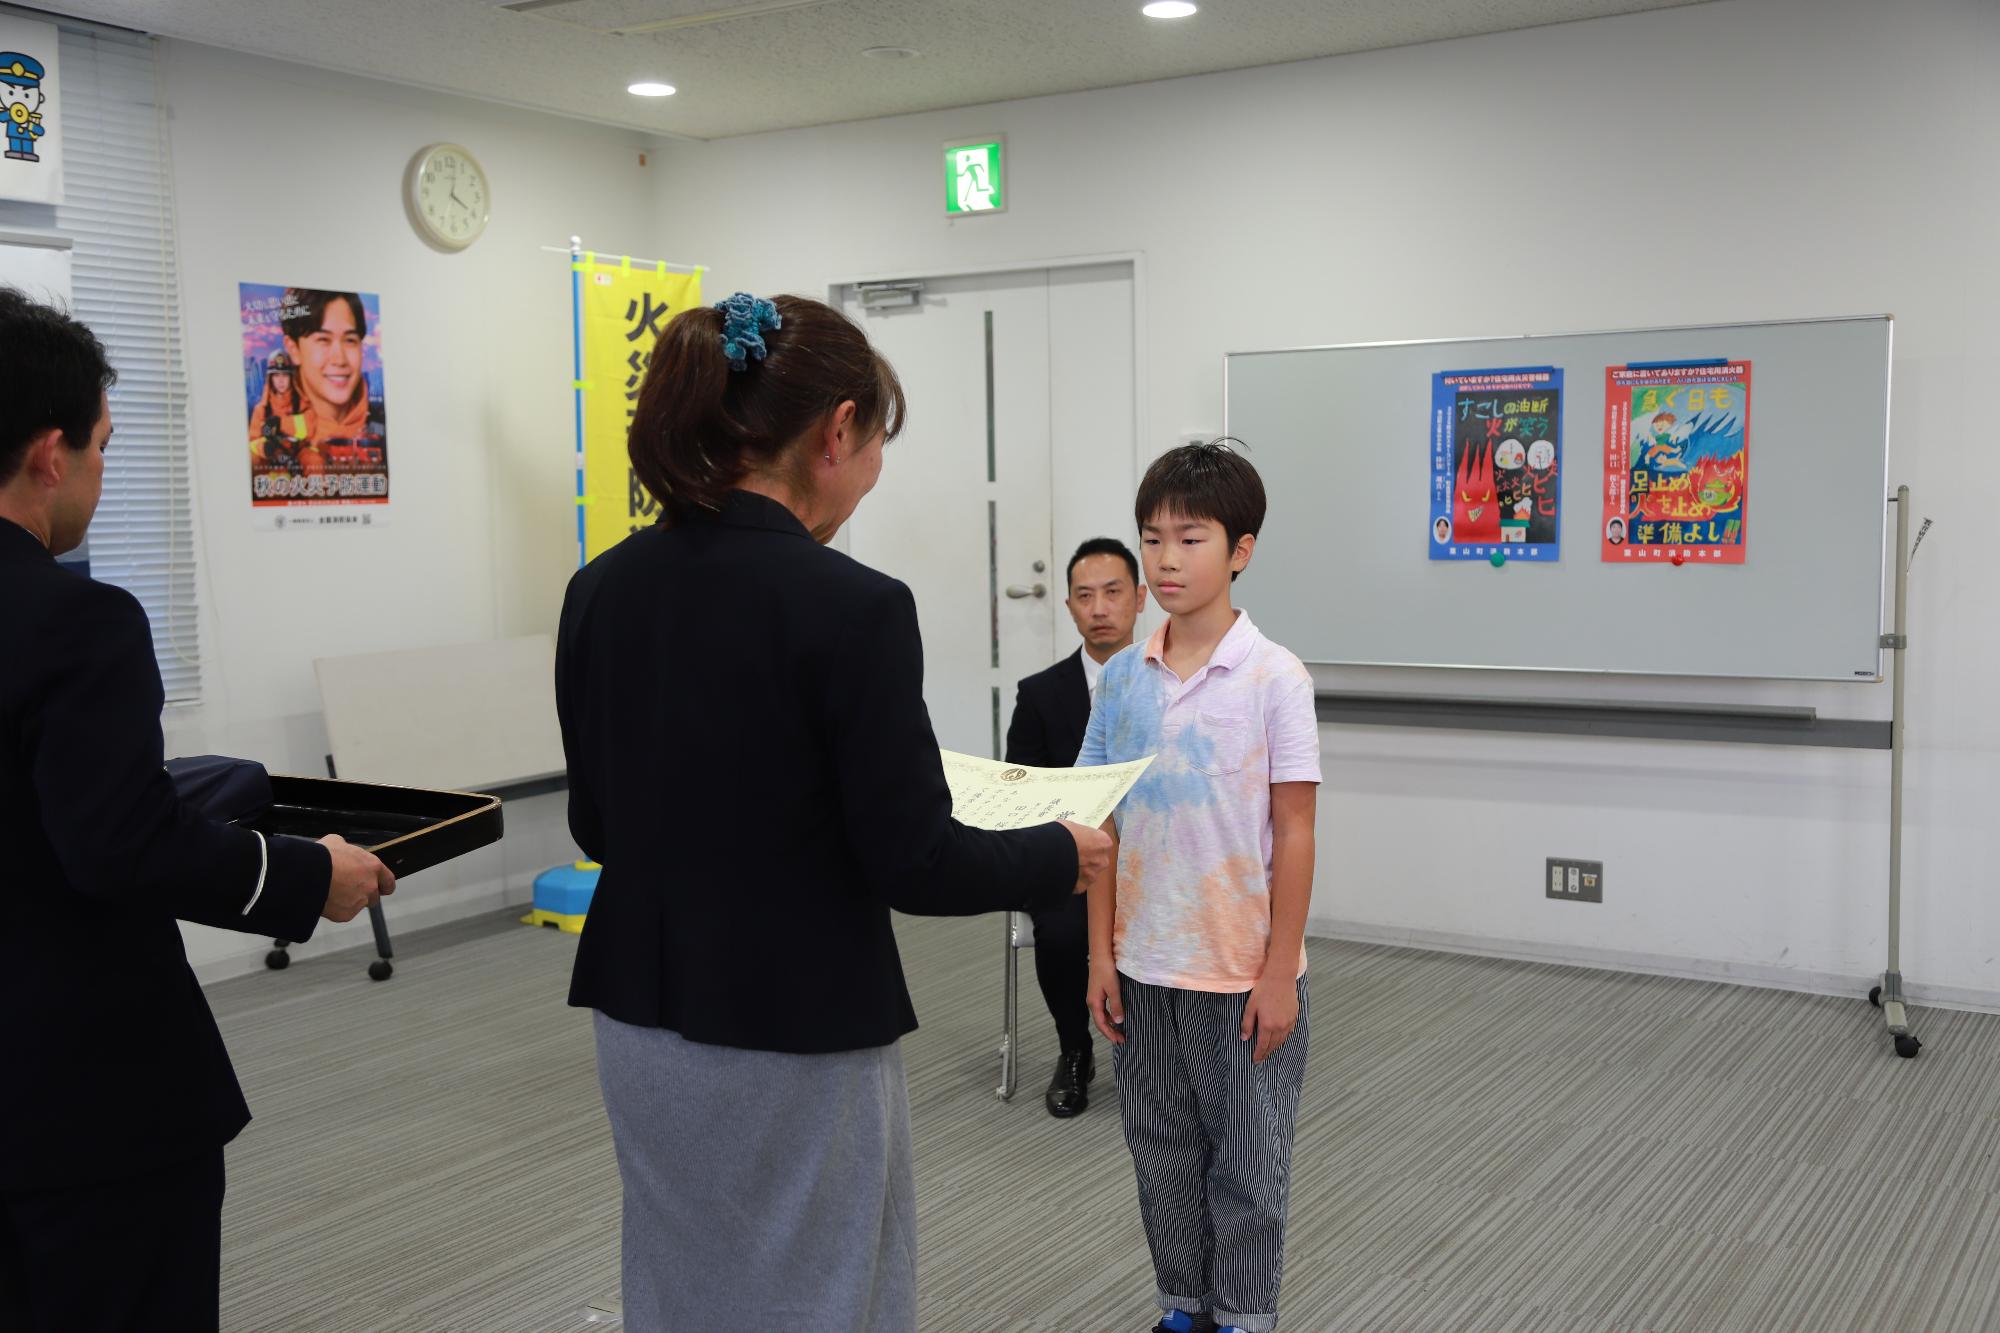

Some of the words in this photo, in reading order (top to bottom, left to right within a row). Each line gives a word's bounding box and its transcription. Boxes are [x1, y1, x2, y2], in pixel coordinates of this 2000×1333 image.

[1641, 387, 1735, 412] 急ぐ日も
[254, 474, 388, 498] 秋の火災予防運動
[1630, 469, 1690, 493] 足止め
[1629, 492, 1713, 520] 火を止め
